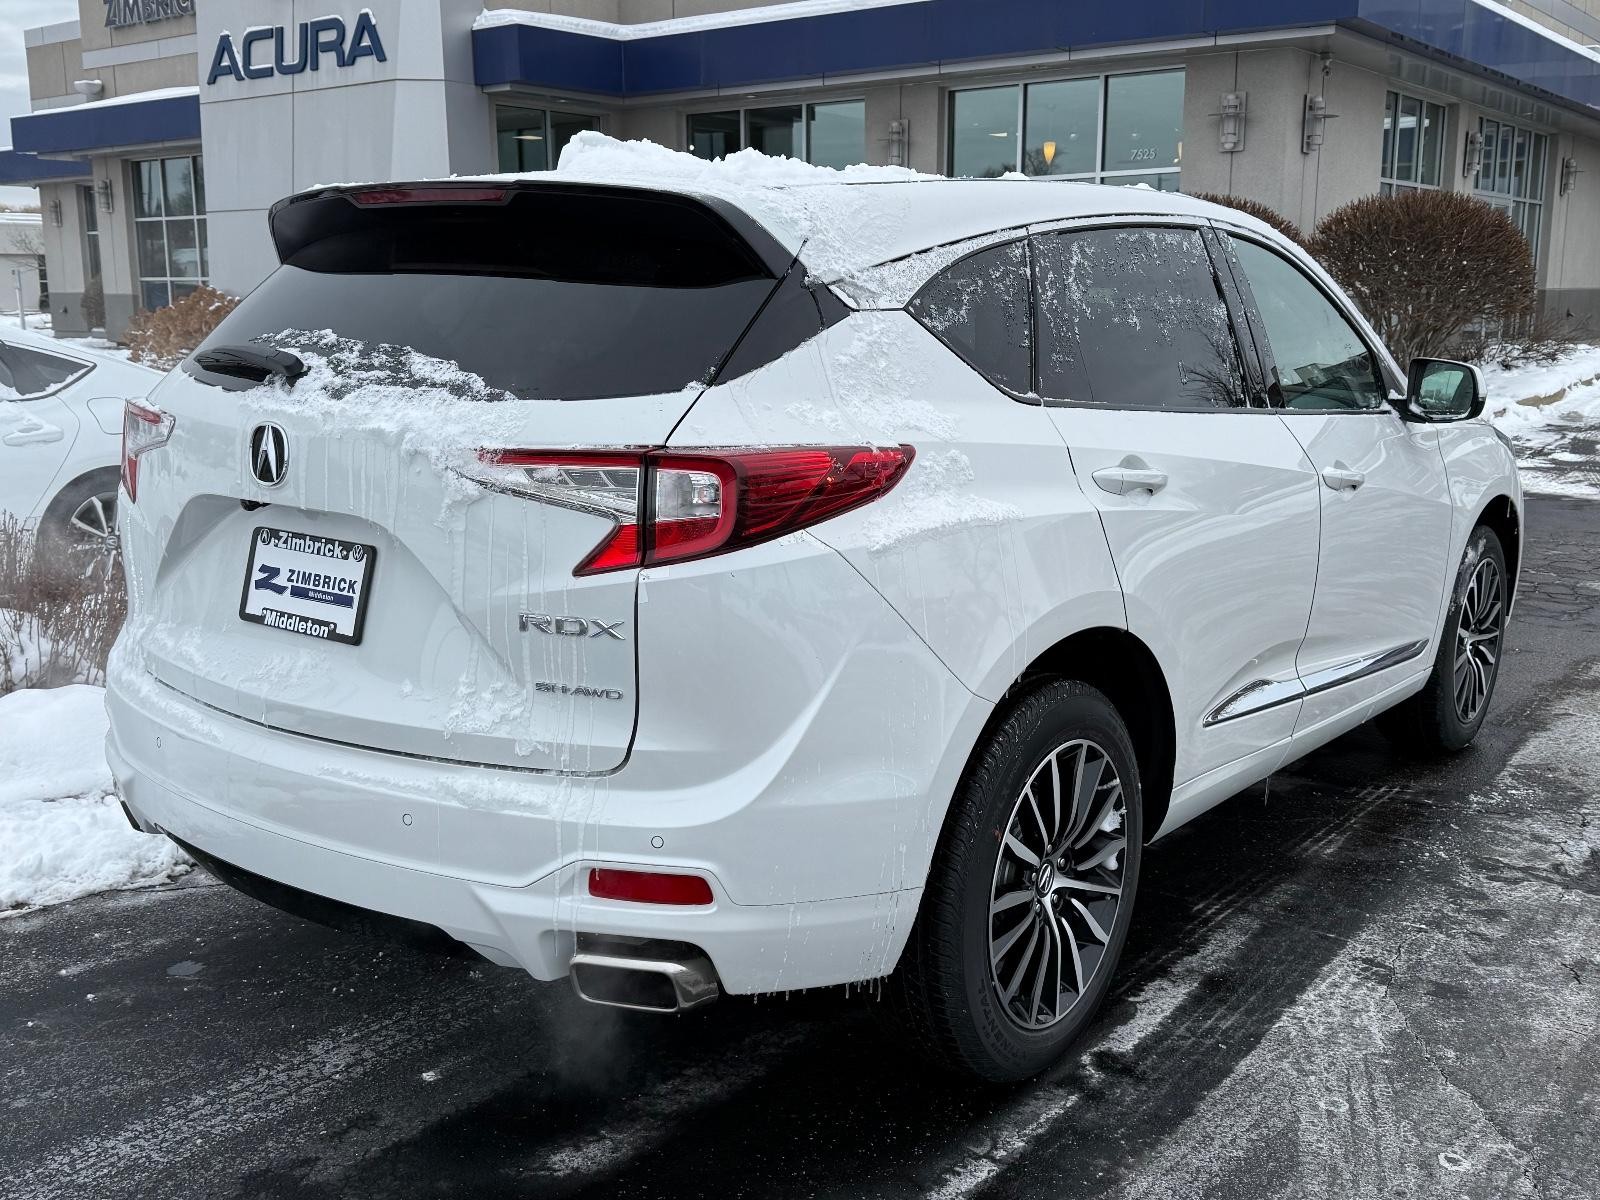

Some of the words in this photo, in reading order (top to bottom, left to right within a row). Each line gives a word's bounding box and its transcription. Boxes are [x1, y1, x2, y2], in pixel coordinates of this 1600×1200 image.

[207, 8, 387, 86] ACURA
[1130, 148, 1156, 161] 7525
[278, 531, 344, 559] Zimbrick
[286, 568, 358, 594] ZIMBRICK
[263, 611, 329, 638] Middleton
[518, 613, 625, 640] RDX
